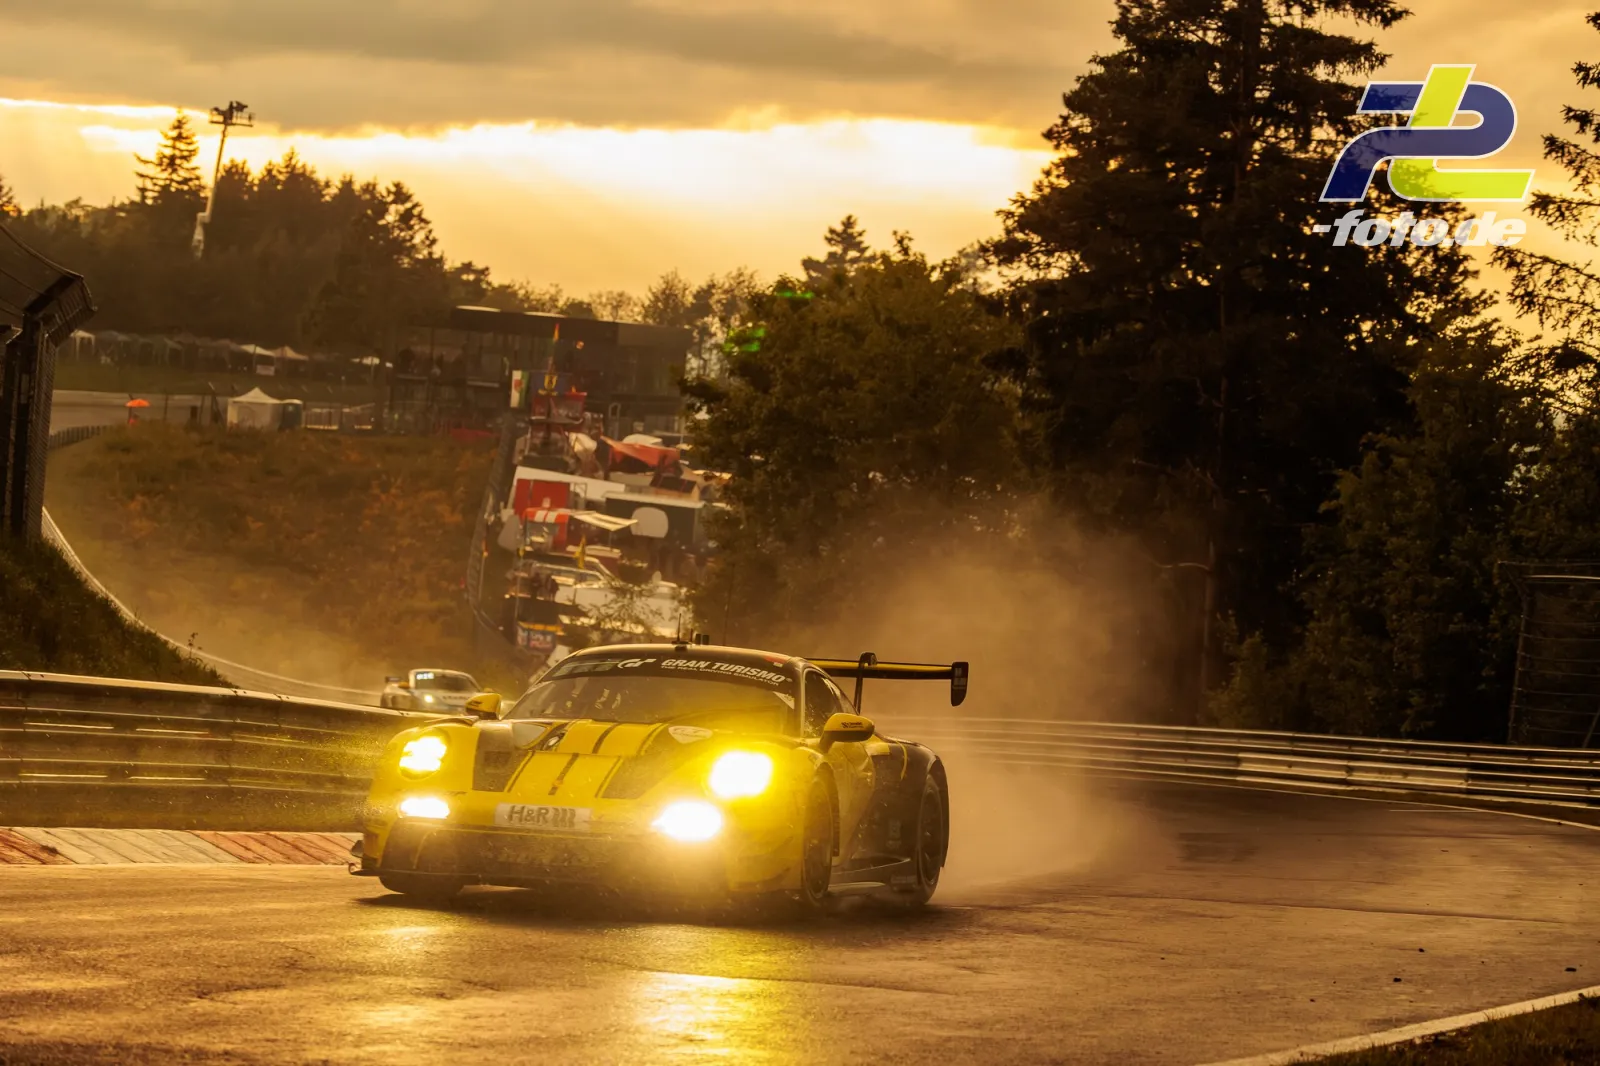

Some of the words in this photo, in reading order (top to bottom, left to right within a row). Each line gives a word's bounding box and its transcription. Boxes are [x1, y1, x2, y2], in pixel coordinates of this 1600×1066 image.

[661, 658, 709, 668] GRAN
[711, 662, 786, 683] TURISMO
[699, 668, 732, 676] DRIVING
[733, 672, 780, 686] SIMULATOR
[508, 805, 549, 824] H&R
